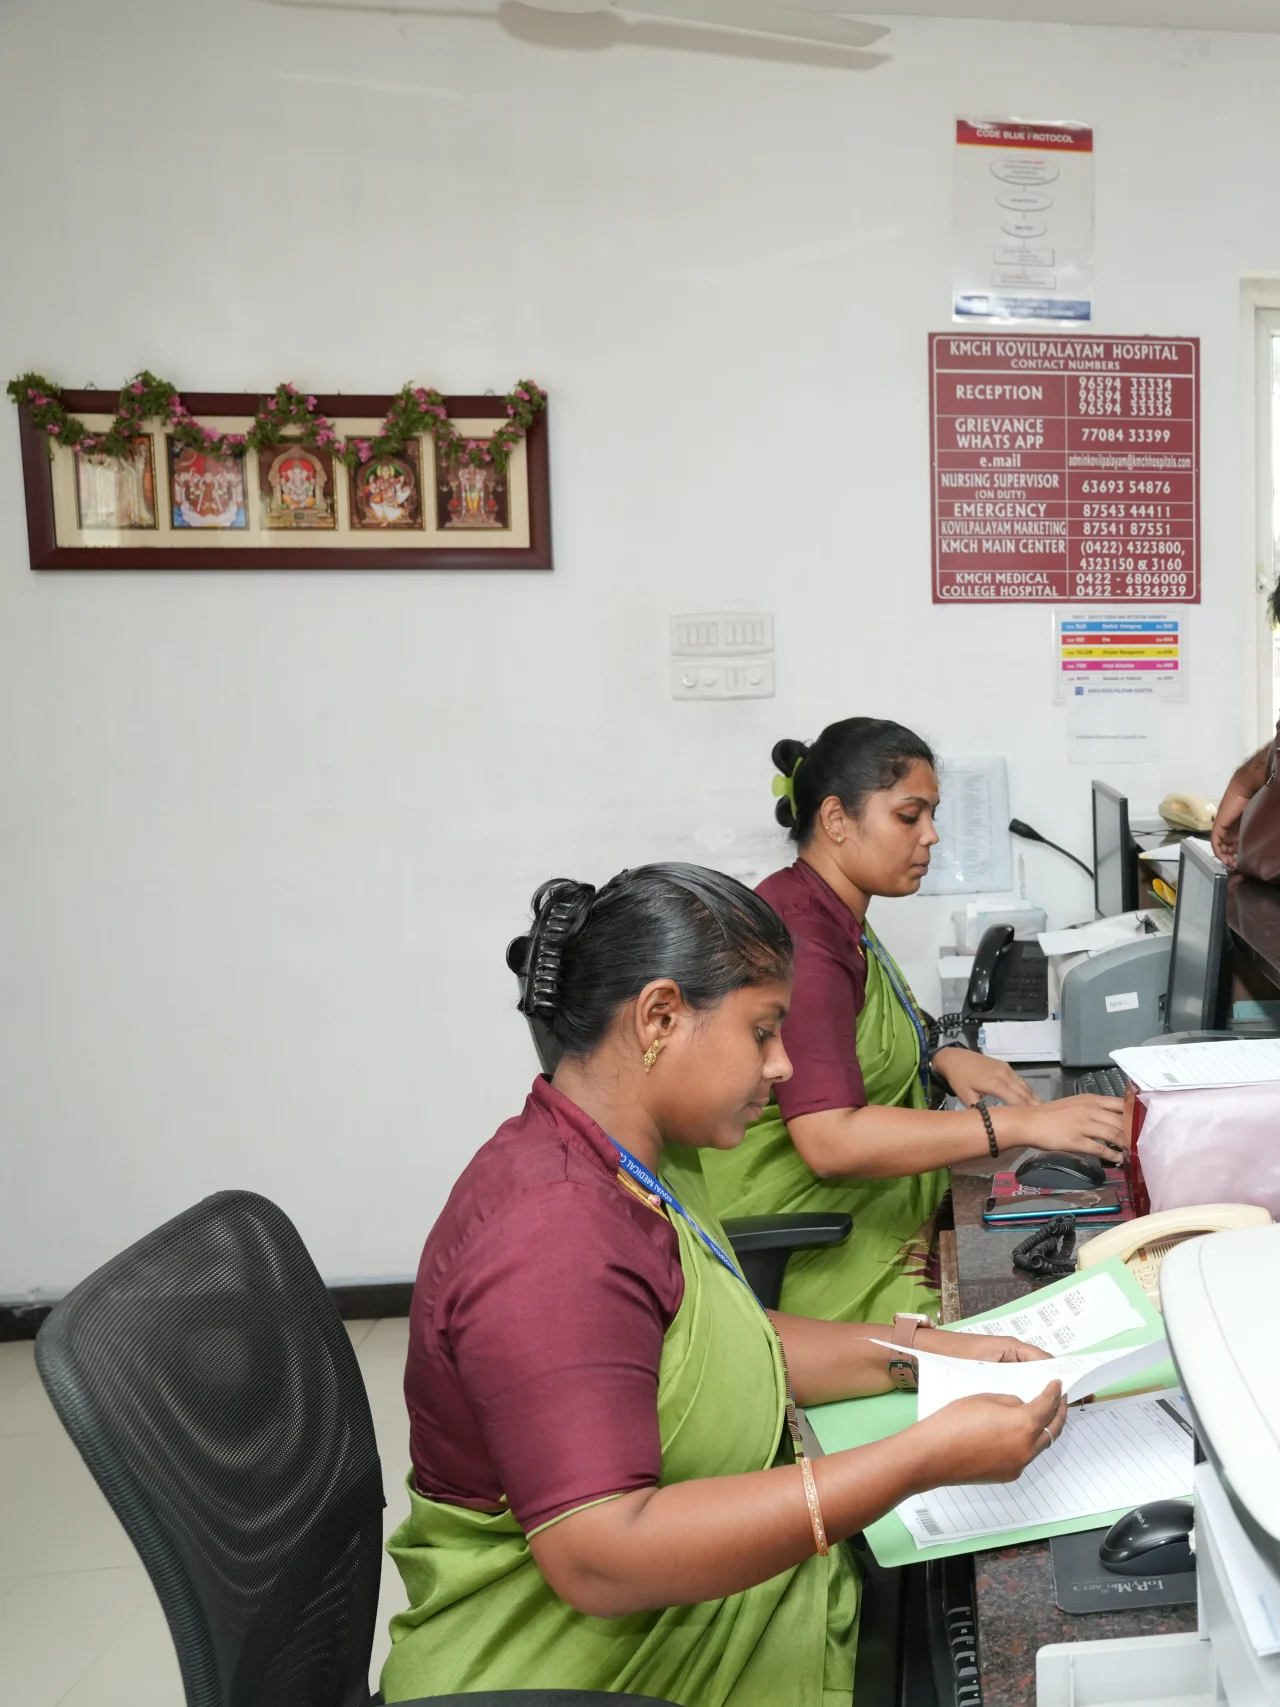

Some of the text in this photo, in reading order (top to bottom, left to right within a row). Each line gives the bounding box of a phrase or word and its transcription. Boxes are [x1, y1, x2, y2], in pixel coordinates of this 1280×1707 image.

[1003, 131, 1025, 140] BLUE
[950, 341, 1178, 360] KMCH KOVILPALAYAM HOSPITAL
[1011, 359, 1120, 370] CONTACT NUMBERS
[1079, 377, 1172, 391] 96594 33334
[956, 385, 1042, 400] RECEPTION
[1079, 390, 1172, 404] 96594 33335
[1079, 402, 1172, 416] 96594 33336
[955, 418, 1043, 432] GRIEVANCE
[957, 435, 1043, 449] WHATS APP
[1082, 429, 1170, 442] 77084 33399
[941, 473, 1059, 488] NURSING SUPERVISOR
[1082, 481, 1170, 494] 63693 54876
[975, 490, 1026, 500] (ON DUTY)
[954, 503, 1046, 517] EMERGENCY
[1083, 504, 1170, 517] 87543 44411
[941, 521, 1066, 536] KOVILPALAYAM MARKETING
[1083, 522, 1170, 535] 87541 87551
[942, 539, 1065, 554] KMCH MAIN CENTER
[1081, 540, 1185, 556] (0422) 4323800,
[1080, 558, 1133, 570] 4323150
[1152, 558, 1182, 570] 3160
[956, 573, 1049, 584] KMCH MEDICAL
[1076, 574, 1111, 584] 0422
[1126, 573, 1187, 584] 6806000
[942, 586, 1058, 597] COLLEGE HOSPITAL
[1076, 586, 1111, 596] 0422
[1126, 586, 1186, 597] 4324939
[626, 1159, 672, 1204] KOVAI MEDICAL
